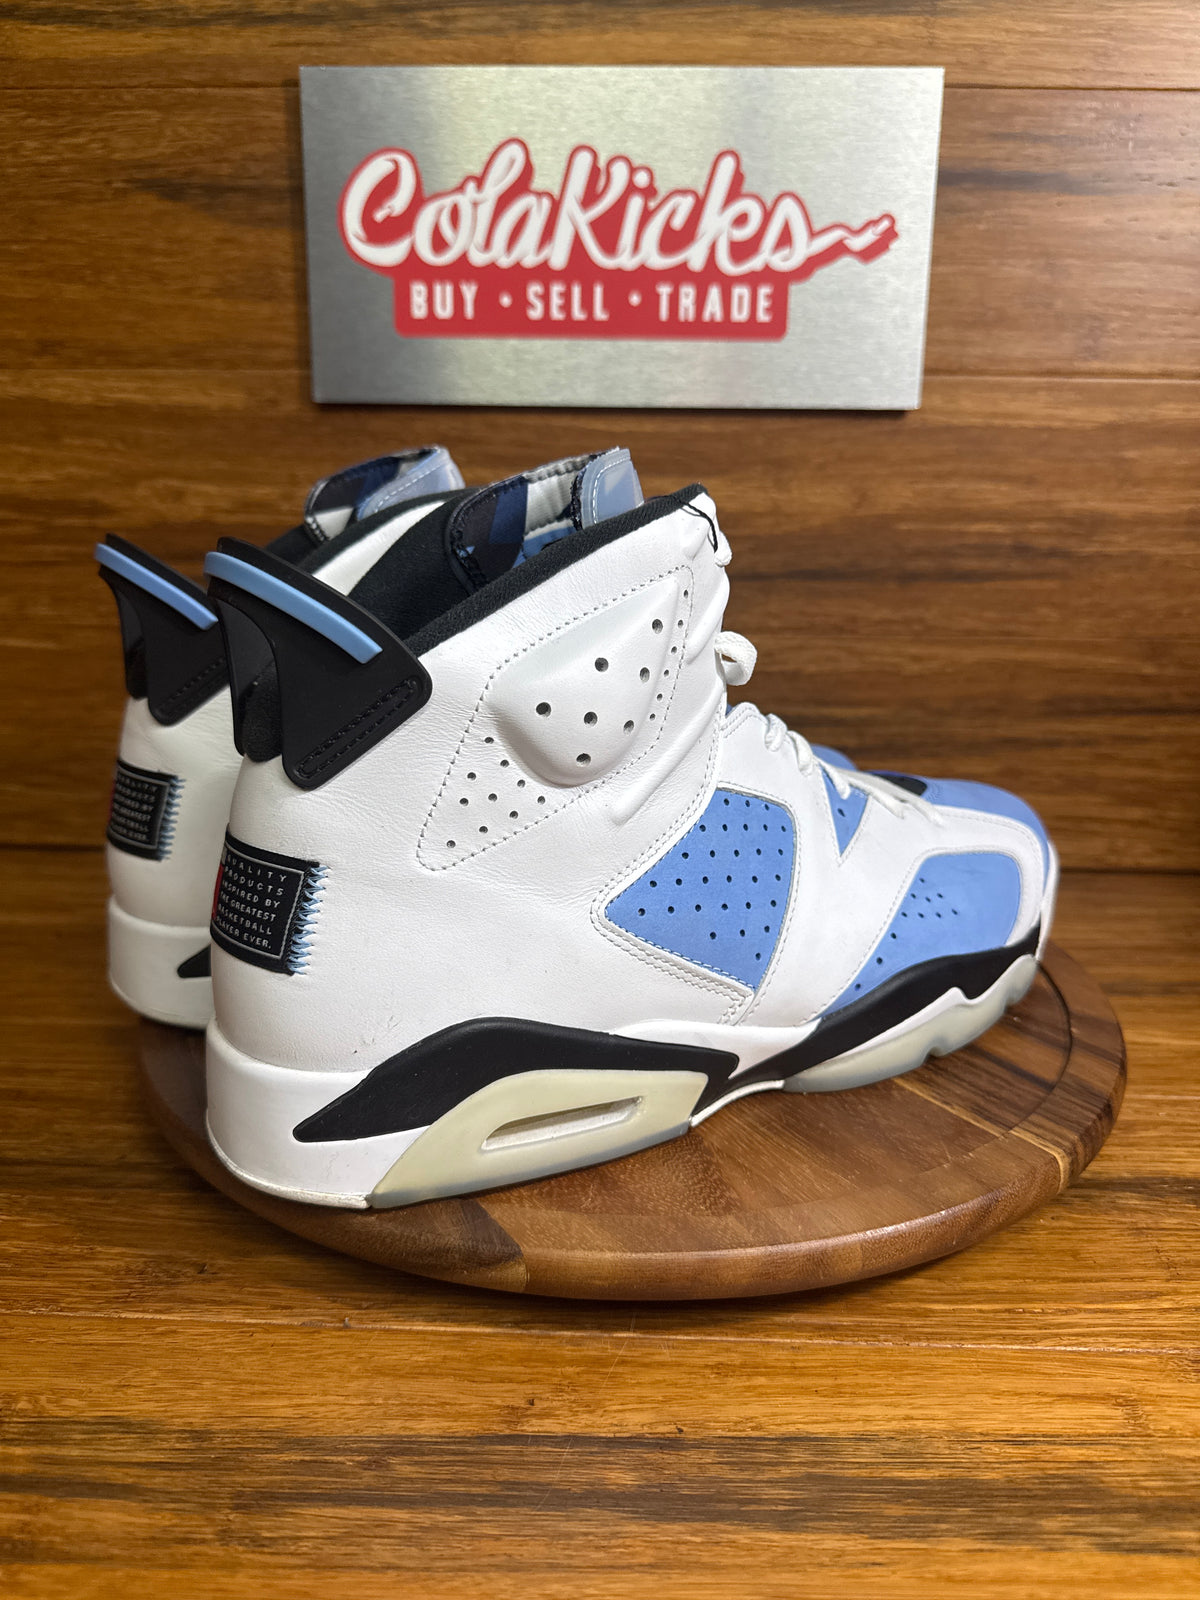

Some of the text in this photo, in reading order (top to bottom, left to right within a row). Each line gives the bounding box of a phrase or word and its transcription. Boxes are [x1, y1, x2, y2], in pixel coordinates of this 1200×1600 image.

[340, 139, 897, 275] ColaKicks
[409, 281, 775, 324] BUY SELL TRADE
[224, 865, 284, 896] PRODUCTS
[218, 903, 272, 935] BASKETBALL
[230, 900, 277, 921] GREATEST
[264, 898, 281, 909] BY
[243, 934, 272, 949] EVER.
